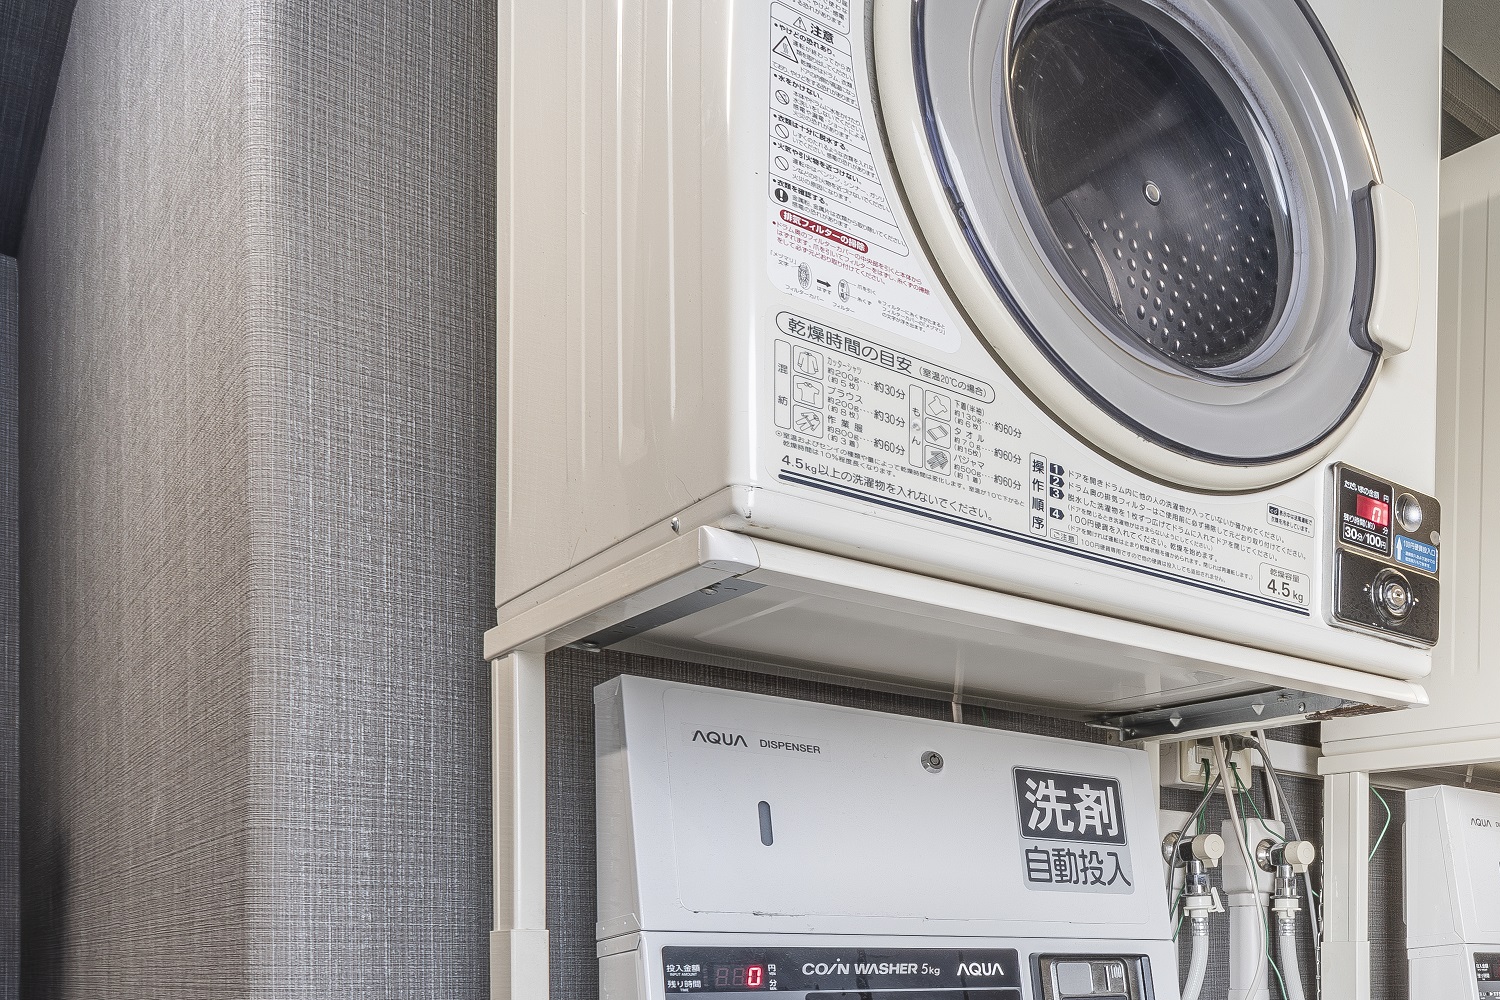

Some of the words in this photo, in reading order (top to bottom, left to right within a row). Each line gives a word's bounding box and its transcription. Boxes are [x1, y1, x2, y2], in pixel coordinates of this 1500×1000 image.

[779, 24, 836, 57] やけどの恐れあり。
[811, 23, 834, 44] 注意
[779, 74, 823, 100] 水をかけない。
[778, 114, 849, 152] 衣類は十分に脱水する。
[778, 142, 862, 184] 火気や引火物を近づけない。
[777, 179, 829, 207] 衣類を確認する。
[784, 211, 866, 252] 排気フィルターの掃除
[788, 317, 913, 375] 乾燥時間の目安
[827, 356, 862, 374] カッターシャツ
[827, 386, 863, 404] ブラウス
[873, 381, 906, 400] 約30分
[873, 409, 906, 428] 約30分
[994, 421, 1022, 439] 約60分
[873, 437, 906, 456] 約60分
[994, 447, 1022, 465] 約60分
[953, 454, 985, 469] パジャマ
[782, 455, 993, 522] 4.5kg以上の洗濯物を入れないでください。
[993, 474, 1022, 491] 約60分
[1032, 458, 1045, 530] 操作順序
[1383, 494, 1390, 503] 円
[1053, 531, 1075, 543] ご注意
[1382, 526, 1389, 535] 分
[1269, 567, 1300, 584] 乾燥容量
[692, 729, 748, 749] AQUA
[759, 738, 821, 755] DISPENSER
[1024, 777, 1119, 838] 洗剤
[1470, 817, 1492, 828] AQUA
[1025, 845, 1132, 887] 自動投入
[666, 964, 701, 973] 投入金額
[747, 966, 762, 986] 0
[768, 964, 777, 972] 円
[802, 958, 850, 975] COIN
[854, 963, 918, 975] WASHER
[921, 963, 940, 976] 5kg
[957, 963, 1005, 976] AQUA
[667, 980, 701, 989] 残り時間
[769, 979, 777, 987] 分
